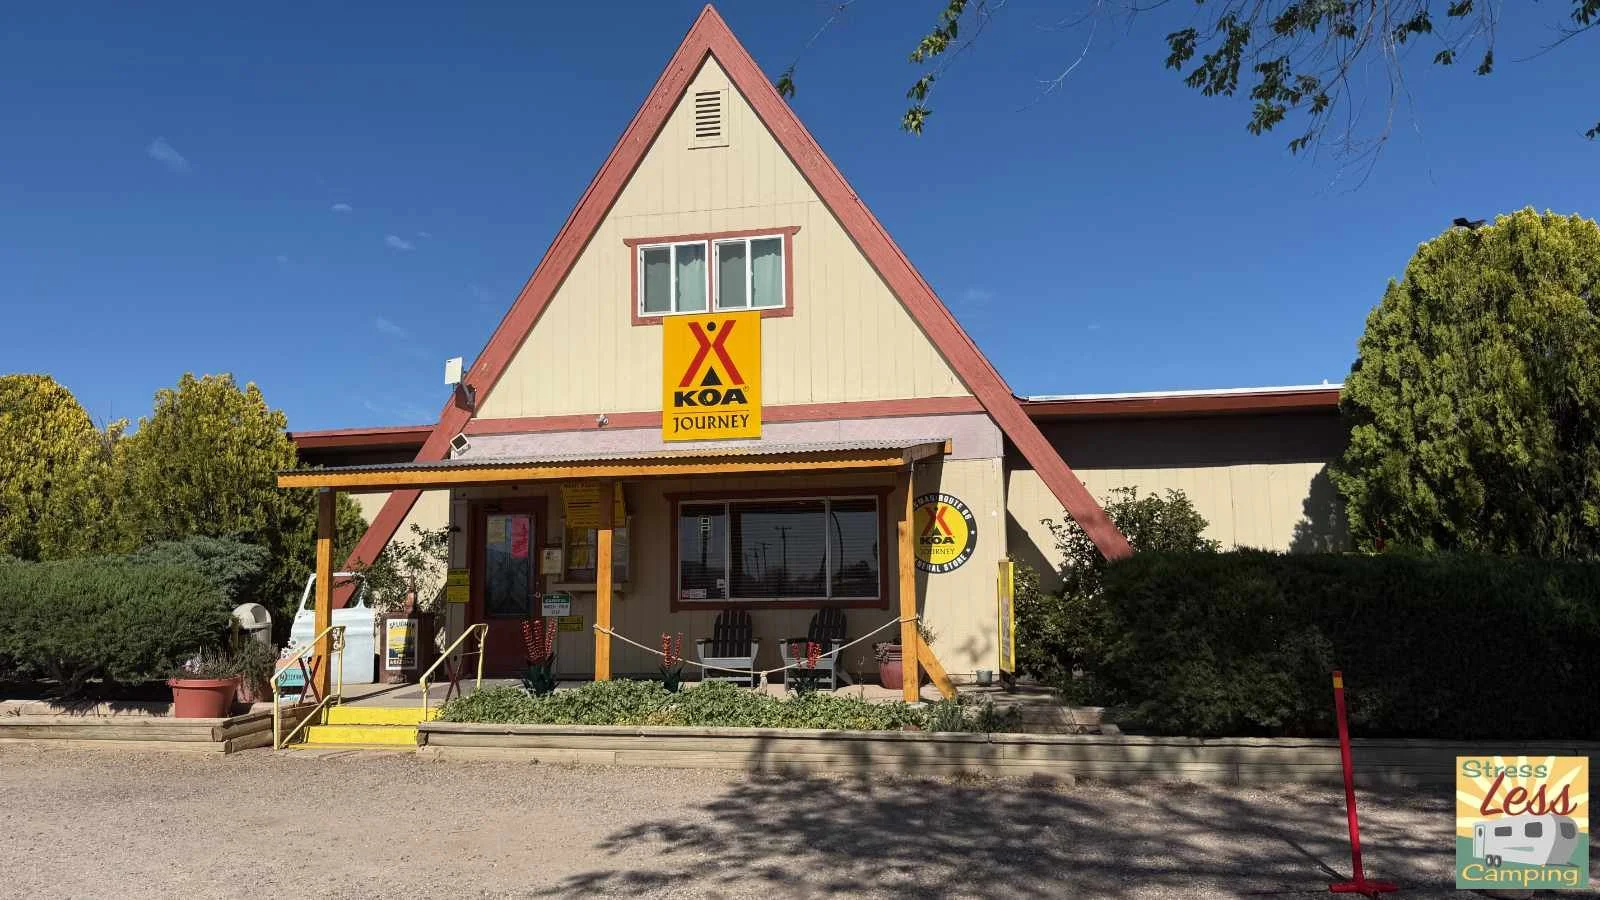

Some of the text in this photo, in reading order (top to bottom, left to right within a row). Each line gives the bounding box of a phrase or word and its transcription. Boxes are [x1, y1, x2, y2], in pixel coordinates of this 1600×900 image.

[674, 388, 748, 407] KOA
[673, 414, 750, 433] JOURNEY
[939, 494, 963, 510] ROUTE
[961, 509, 972, 520] 66
[920, 536, 955, 545] KOA
[943, 554, 967, 571] STORE
